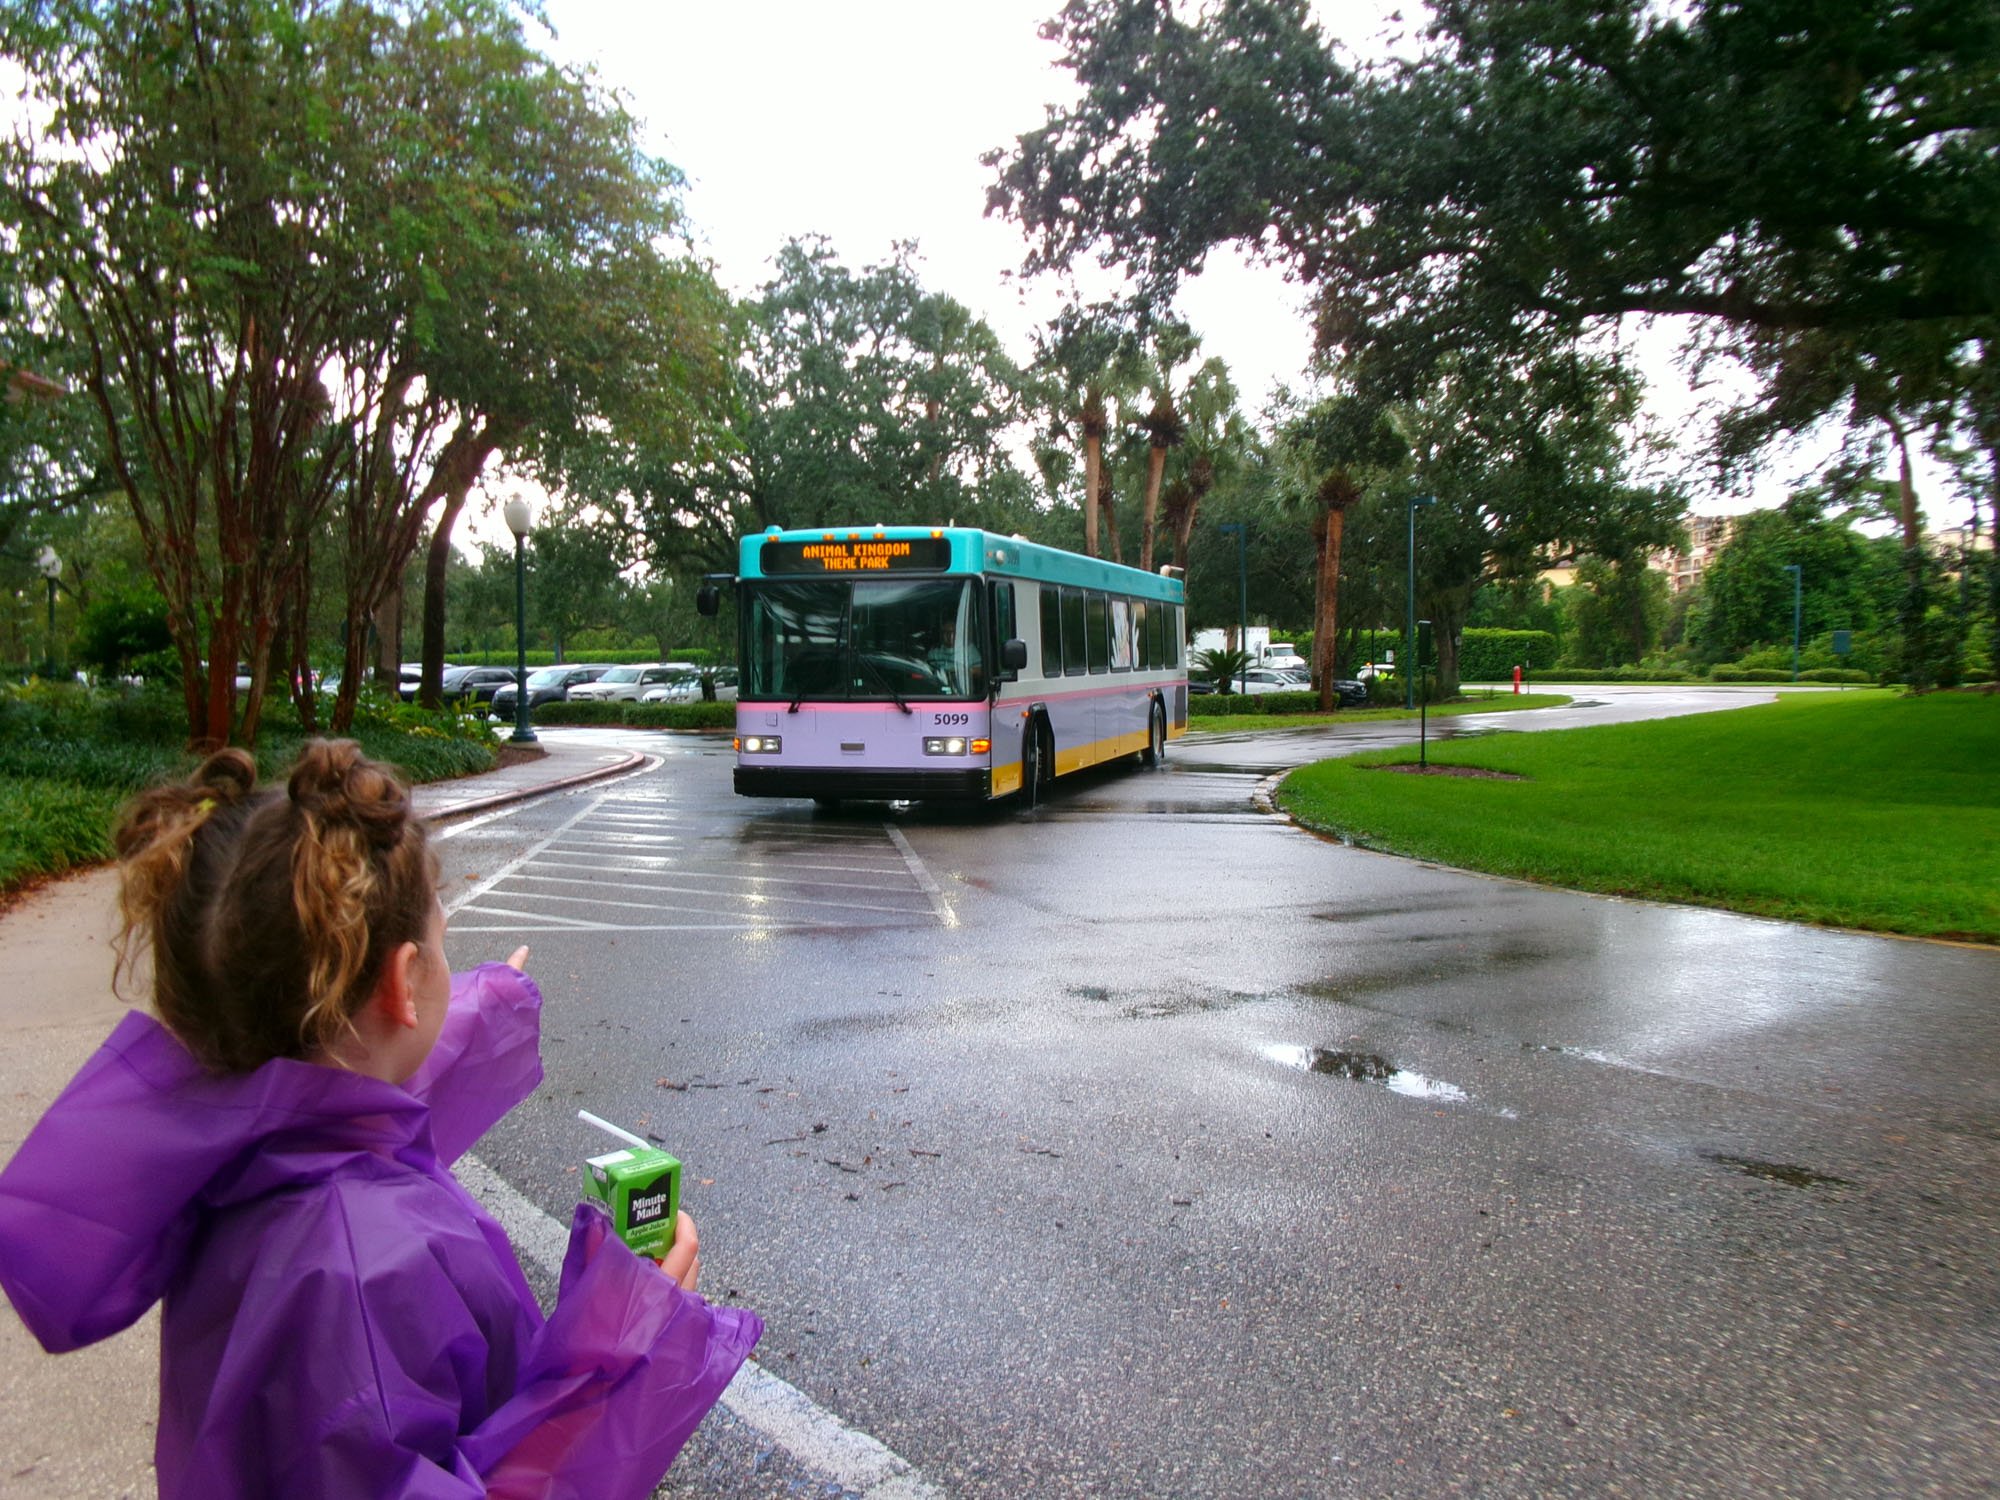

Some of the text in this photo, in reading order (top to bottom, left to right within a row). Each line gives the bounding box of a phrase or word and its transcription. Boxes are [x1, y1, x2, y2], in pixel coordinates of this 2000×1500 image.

[803, 543, 910, 558] ANIMAL KINGDOM
[824, 556, 889, 571] THEME PARK
[934, 713, 969, 726] 5099
[632, 1193, 667, 1211] Minute
[636, 1204, 661, 1221] Maid
